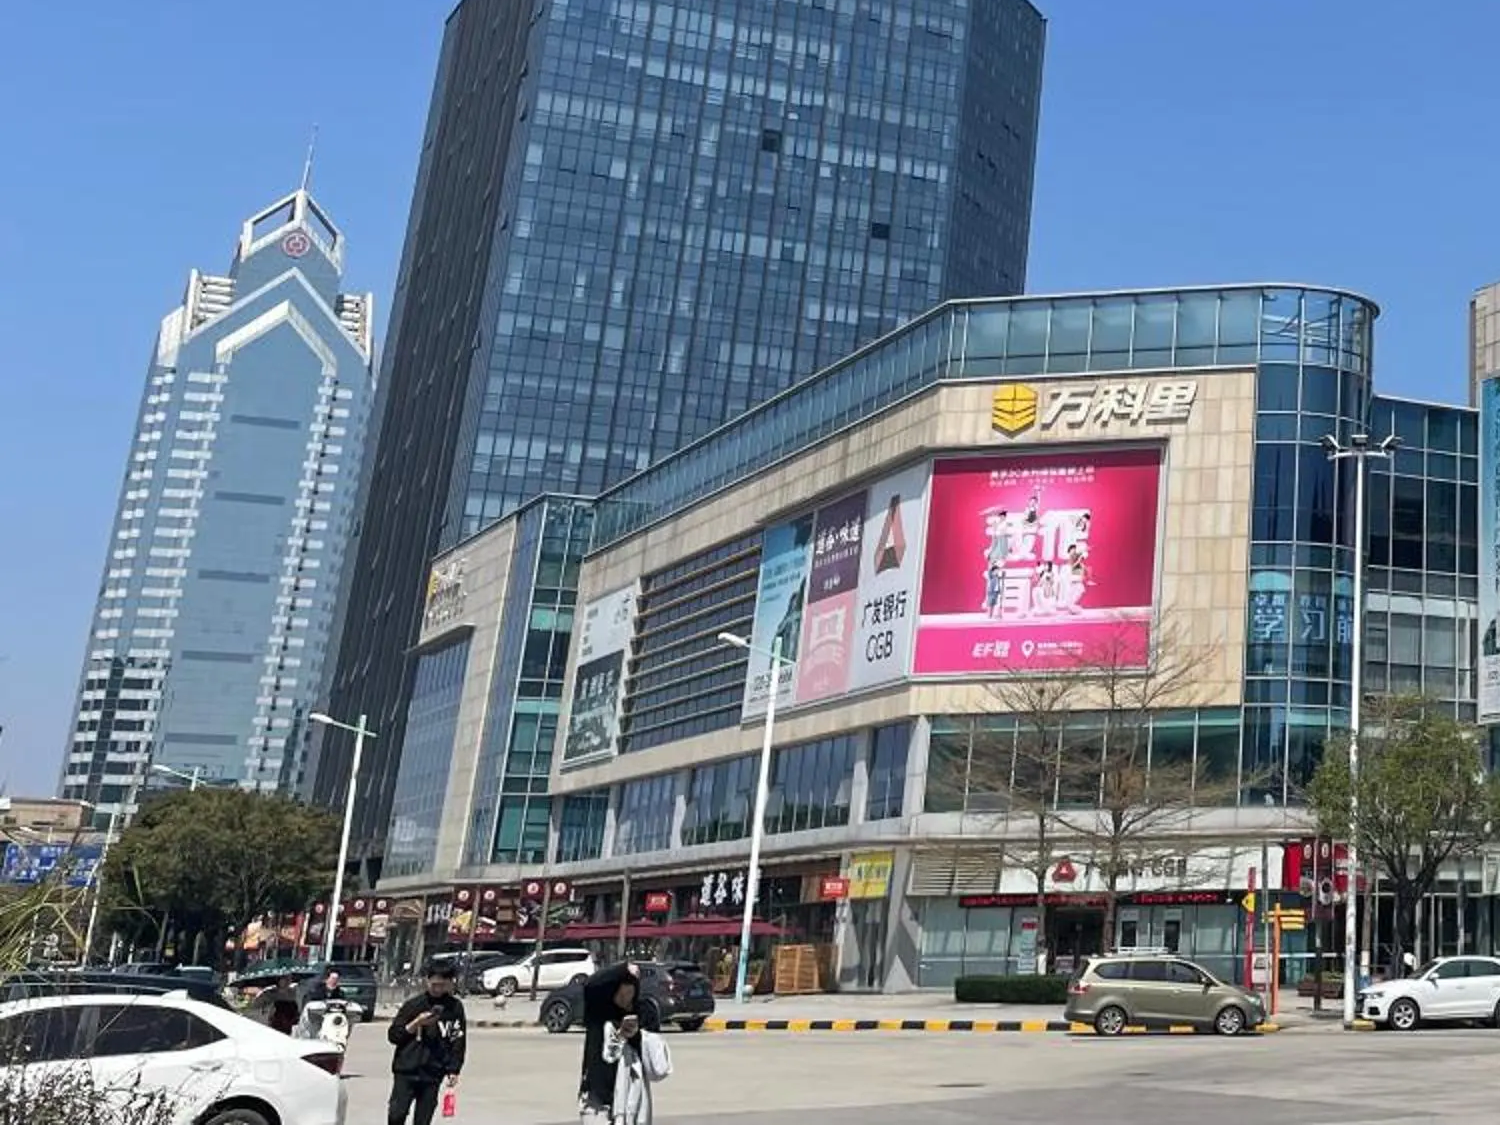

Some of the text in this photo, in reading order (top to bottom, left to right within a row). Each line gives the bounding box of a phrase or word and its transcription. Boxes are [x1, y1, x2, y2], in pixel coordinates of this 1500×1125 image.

[1040, 381, 1197, 430] 万科里
[862, 590, 907, 627] 广发银行
[865, 630, 893, 663] CGB
